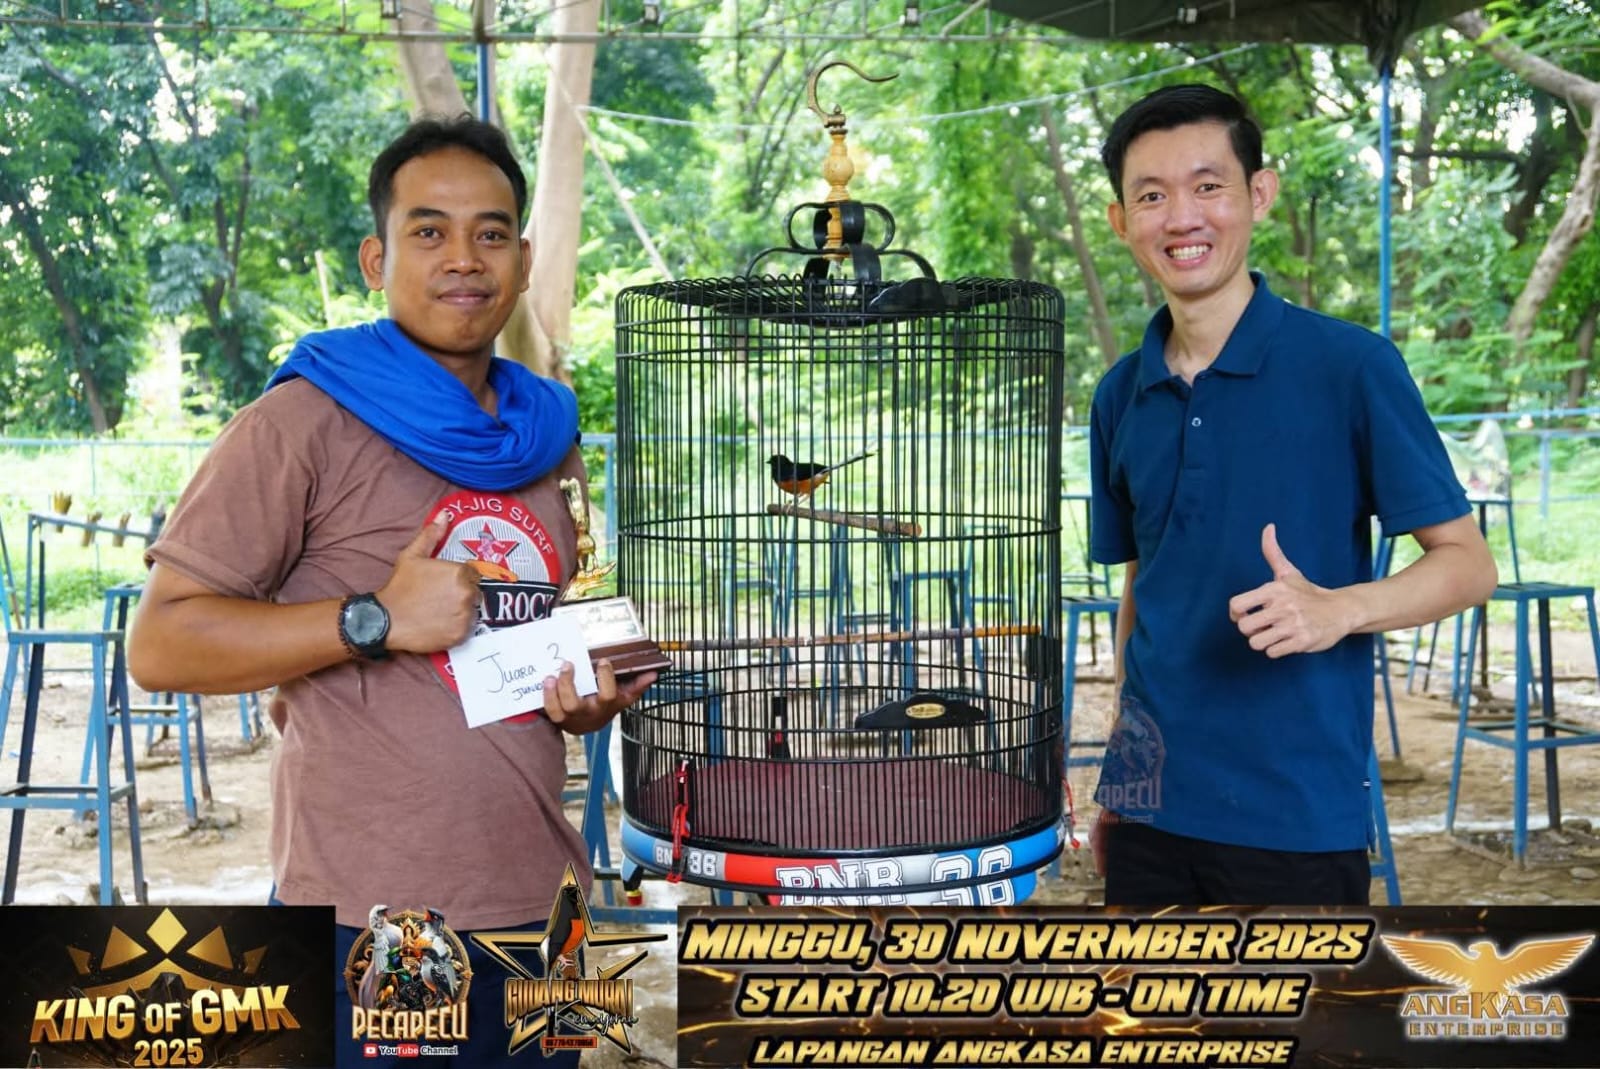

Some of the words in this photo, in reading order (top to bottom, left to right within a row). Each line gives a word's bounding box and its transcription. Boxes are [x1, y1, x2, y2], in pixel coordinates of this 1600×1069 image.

[443, 497, 503, 523] SY-JIG
[509, 506, 554, 555] SURF
[655, 845, 673, 866] BN
[689, 850, 717, 877] 36
[930, 845, 1015, 906] 36
